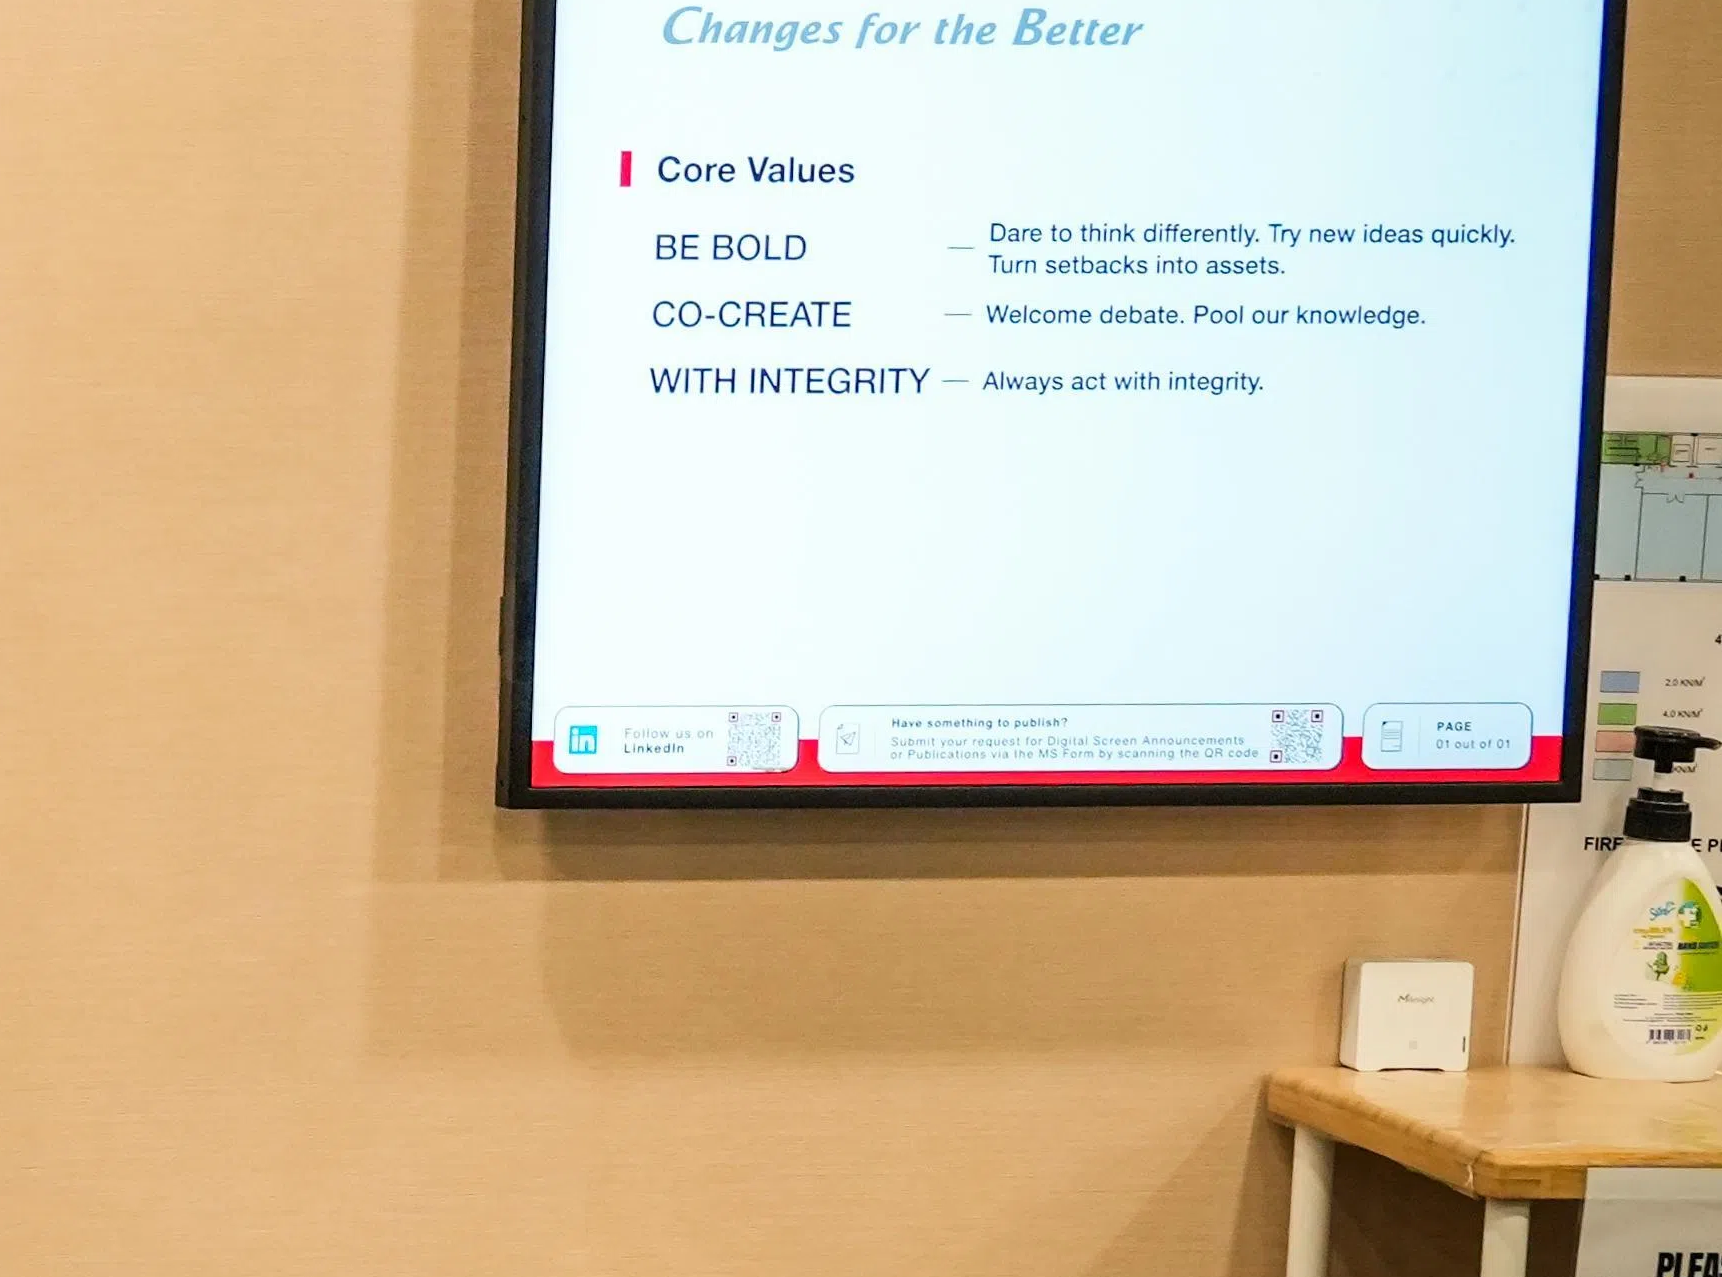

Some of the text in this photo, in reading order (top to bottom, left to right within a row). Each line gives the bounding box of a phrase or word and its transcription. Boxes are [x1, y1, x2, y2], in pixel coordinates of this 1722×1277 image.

[662, 4, 1144, 52] Changes for the Better
[657, 155, 855, 184] Core Values
[655, 233, 807, 262] BE BOLD
[990, 222, 1515, 249] Dare to think differently. Try new ideas quickly.
[988, 254, 1285, 275] Turn setbacks into assets.
[652, 300, 852, 328] CO-CREATE
[986, 304, 1426, 330] Welcome debate. Pool our knowledge.
[649, 367, 931, 395] WITH INTEGRITY
[982, 371, 1264, 396] Always act with integrity.
[624, 728, 714, 739] Follow us on
[891, 717, 1068, 730] Have something to publish?
[1437, 721, 1472, 731] PAGE
[624, 743, 684, 754] LinkedIn
